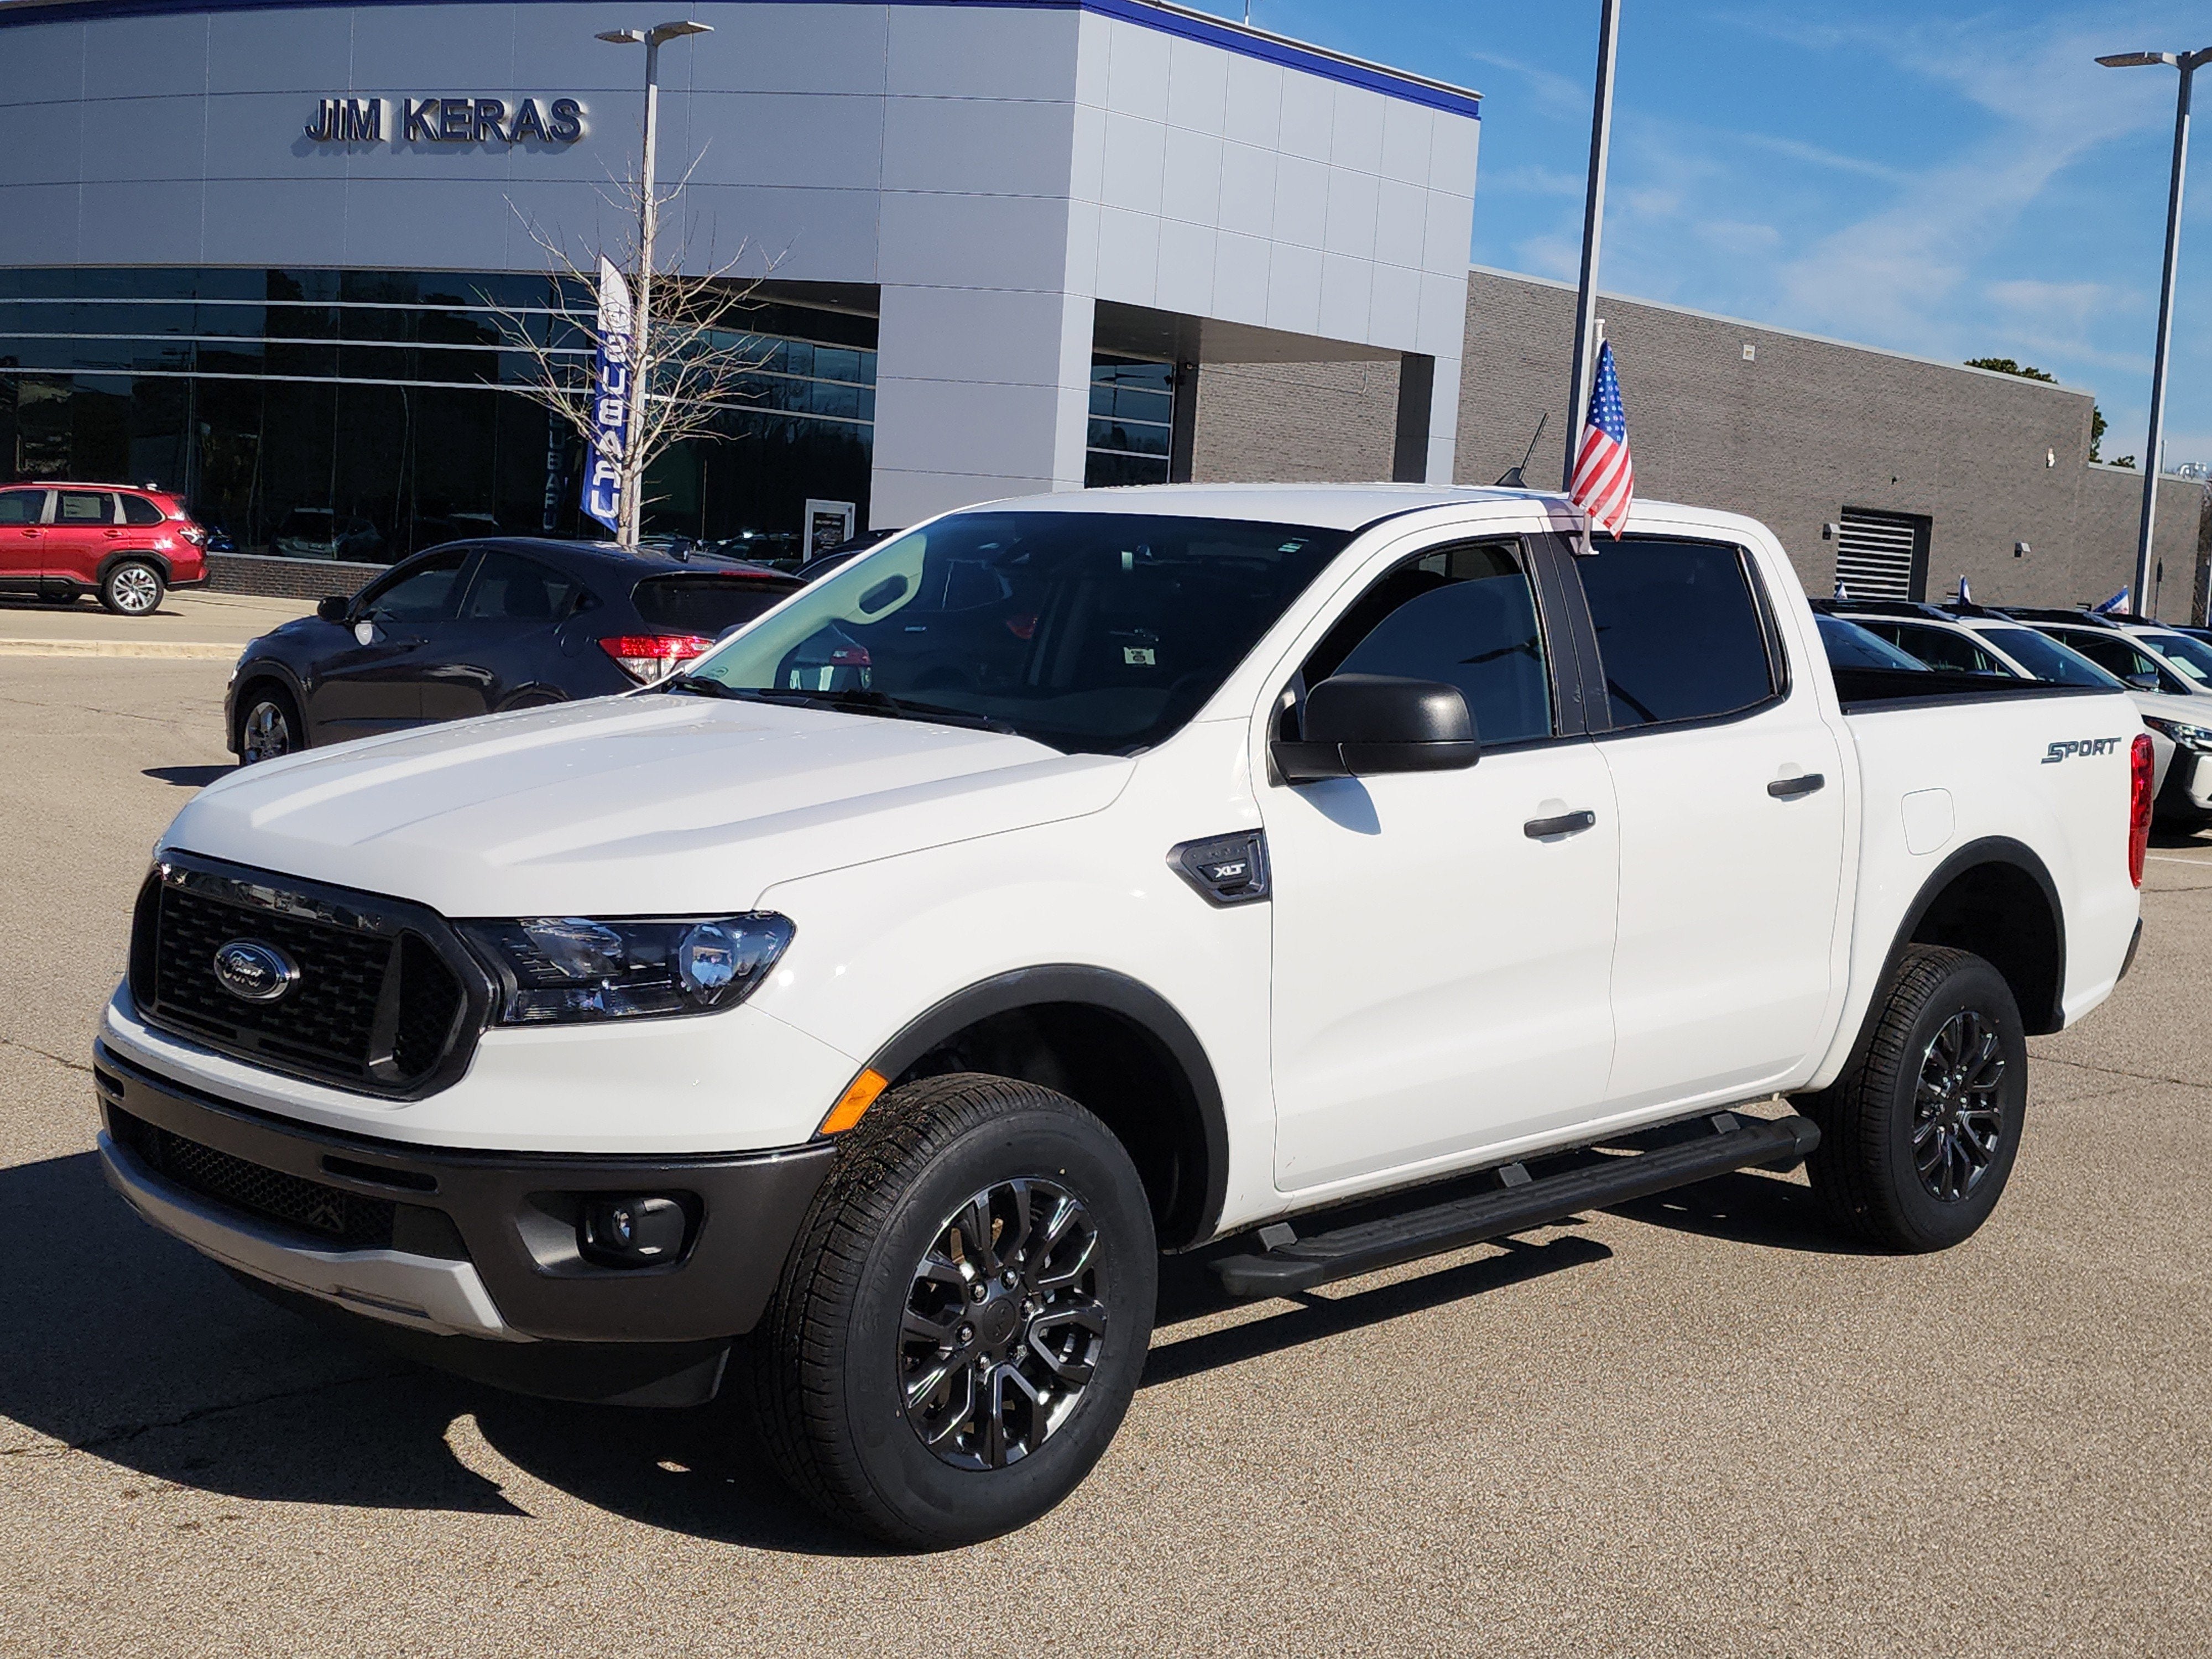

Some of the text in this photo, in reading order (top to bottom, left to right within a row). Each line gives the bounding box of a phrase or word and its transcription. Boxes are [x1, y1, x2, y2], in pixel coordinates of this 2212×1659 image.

[303, 98, 586, 143] JIM KERAS
[2041, 737, 2122, 764] SPORT
[1214, 863, 1246, 878] XLT
